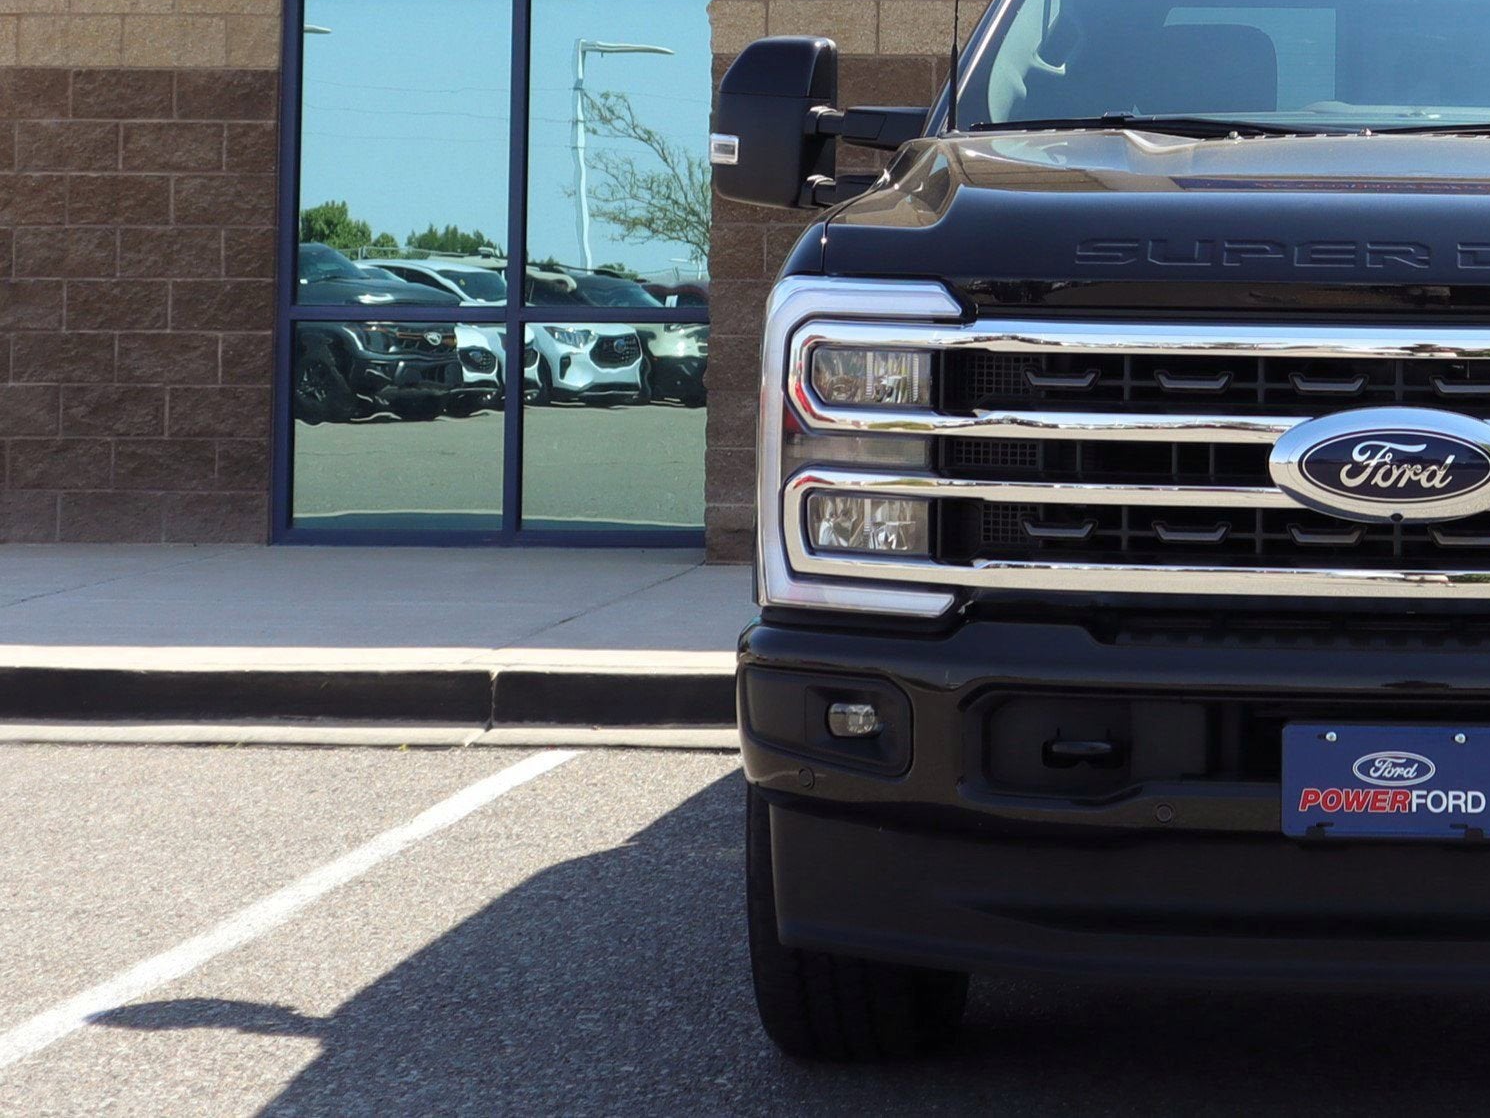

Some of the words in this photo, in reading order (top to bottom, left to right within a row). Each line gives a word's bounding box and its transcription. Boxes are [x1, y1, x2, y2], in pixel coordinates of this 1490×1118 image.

[1075, 239, 1431, 269] SUPER
[1339, 440, 1455, 490] Ford
[1369, 757, 1419, 780] Ford
